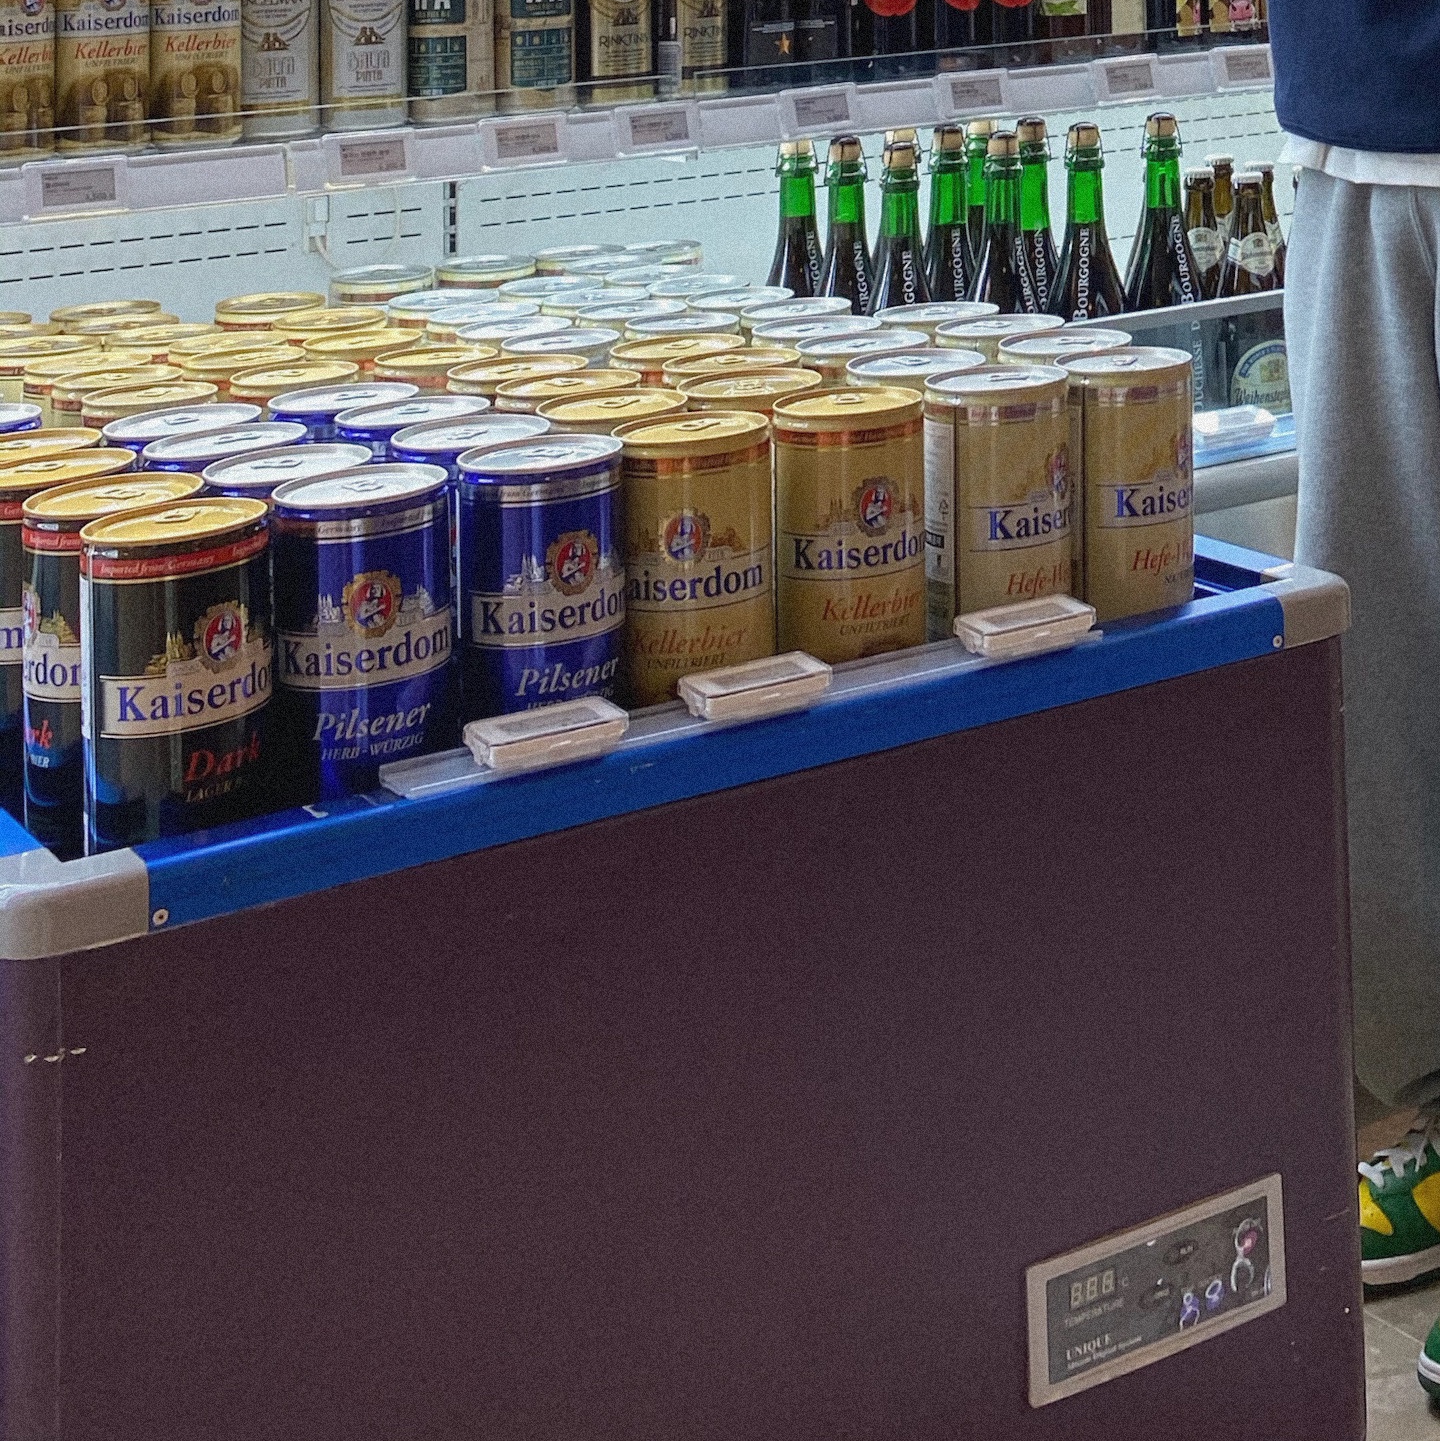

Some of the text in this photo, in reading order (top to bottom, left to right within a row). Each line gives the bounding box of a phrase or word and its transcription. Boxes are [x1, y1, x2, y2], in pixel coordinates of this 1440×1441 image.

[1072, 227, 1090, 322] BOURGOGNE
[1170, 214, 1195, 305] BOURGOGNE
[284, 623, 450, 678] Kaiserdom
[514, 656, 620, 697] Pilsener
[311, 702, 432, 742] Pilsener
[184, 731, 260, 782] Dark
[1066, 1333, 1111, 1362] UNIQUE
